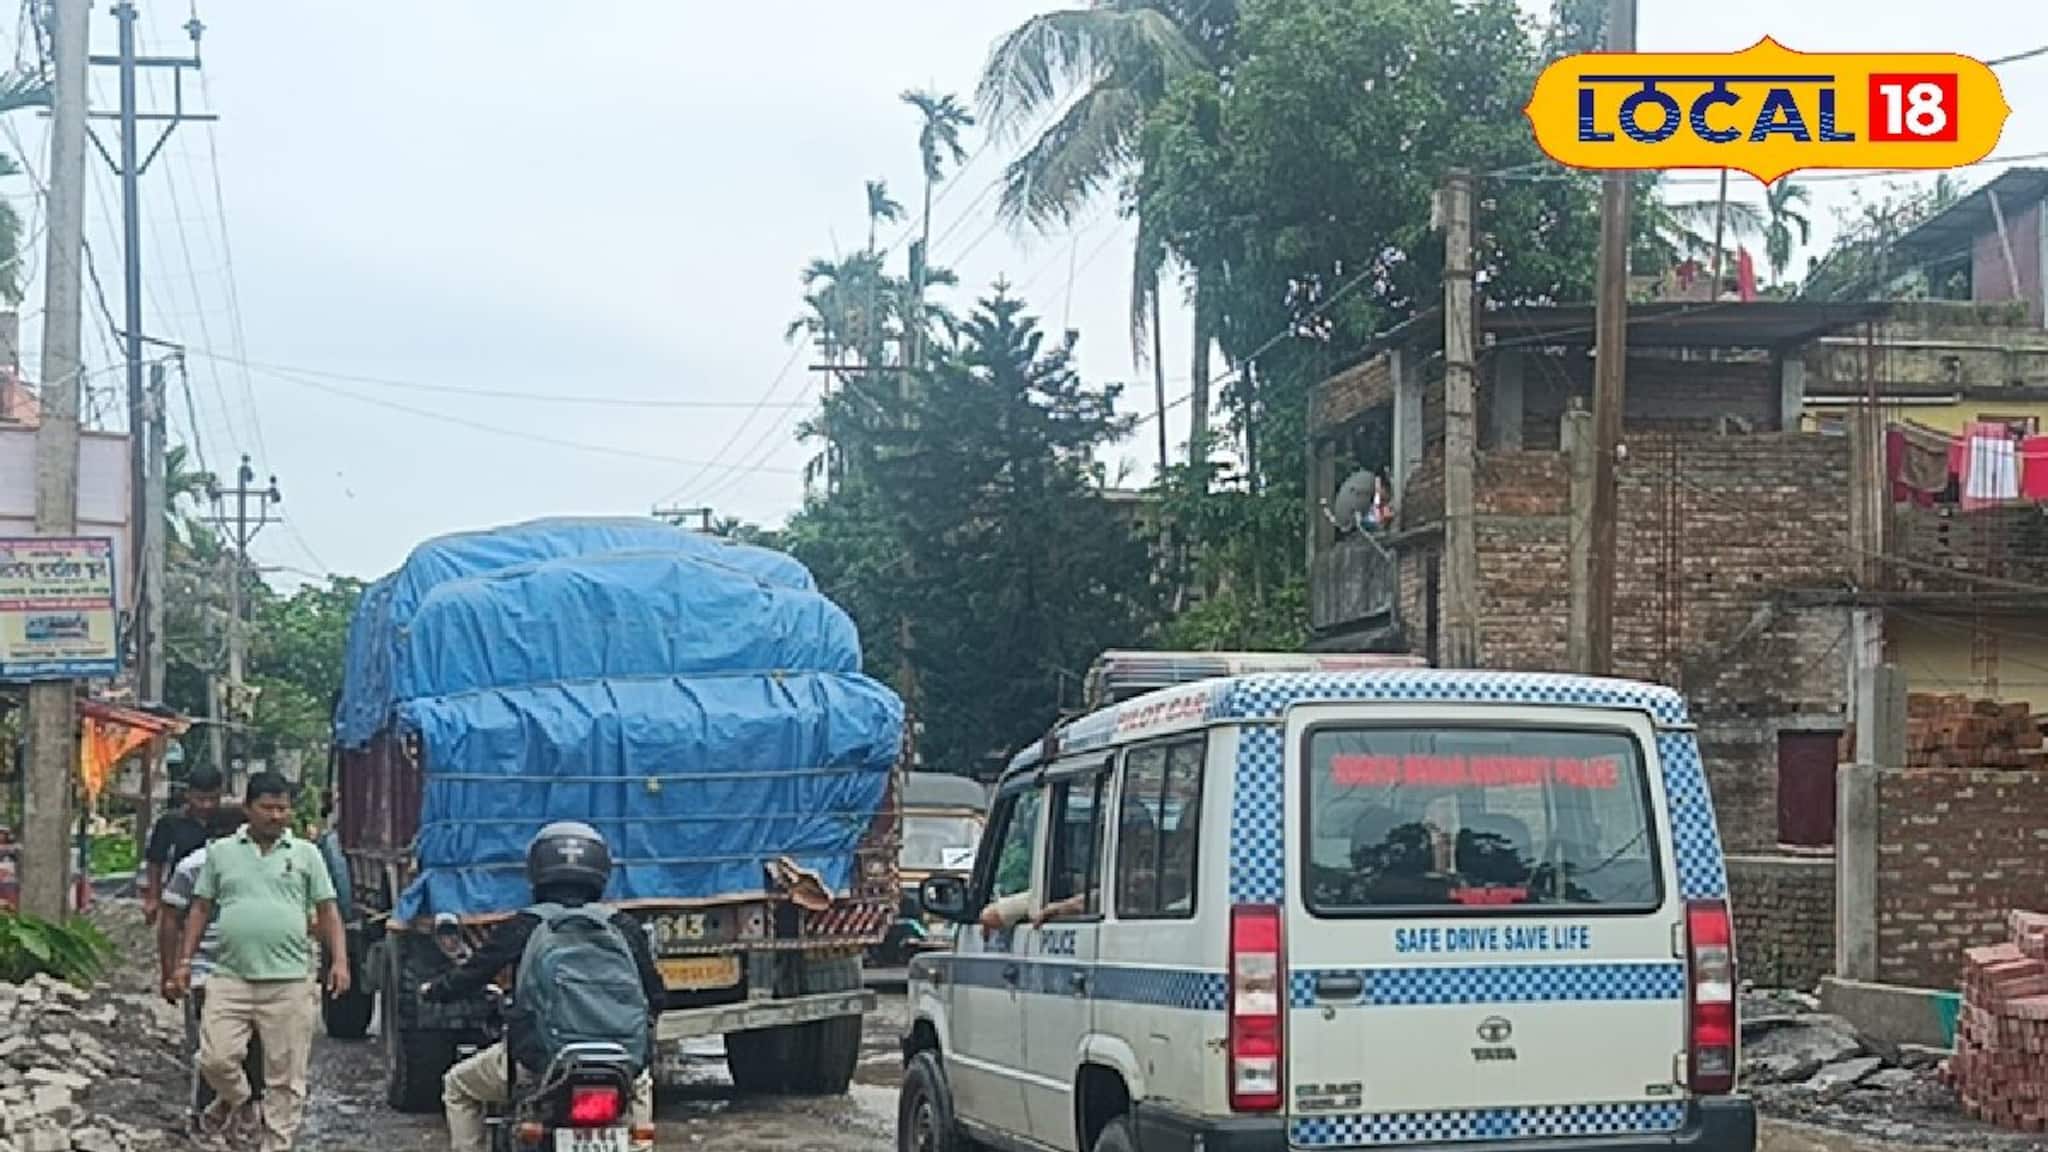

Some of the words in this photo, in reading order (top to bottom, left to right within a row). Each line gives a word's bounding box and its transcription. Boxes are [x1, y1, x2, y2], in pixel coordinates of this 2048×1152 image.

[1395, 928, 1441, 952] SAFE
[1446, 927, 1498, 951] DRIVE
[1504, 926, 1548, 950] SAVE
[1554, 925, 1591, 949] LIFE
[1471, 1047, 1517, 1060] TATA
